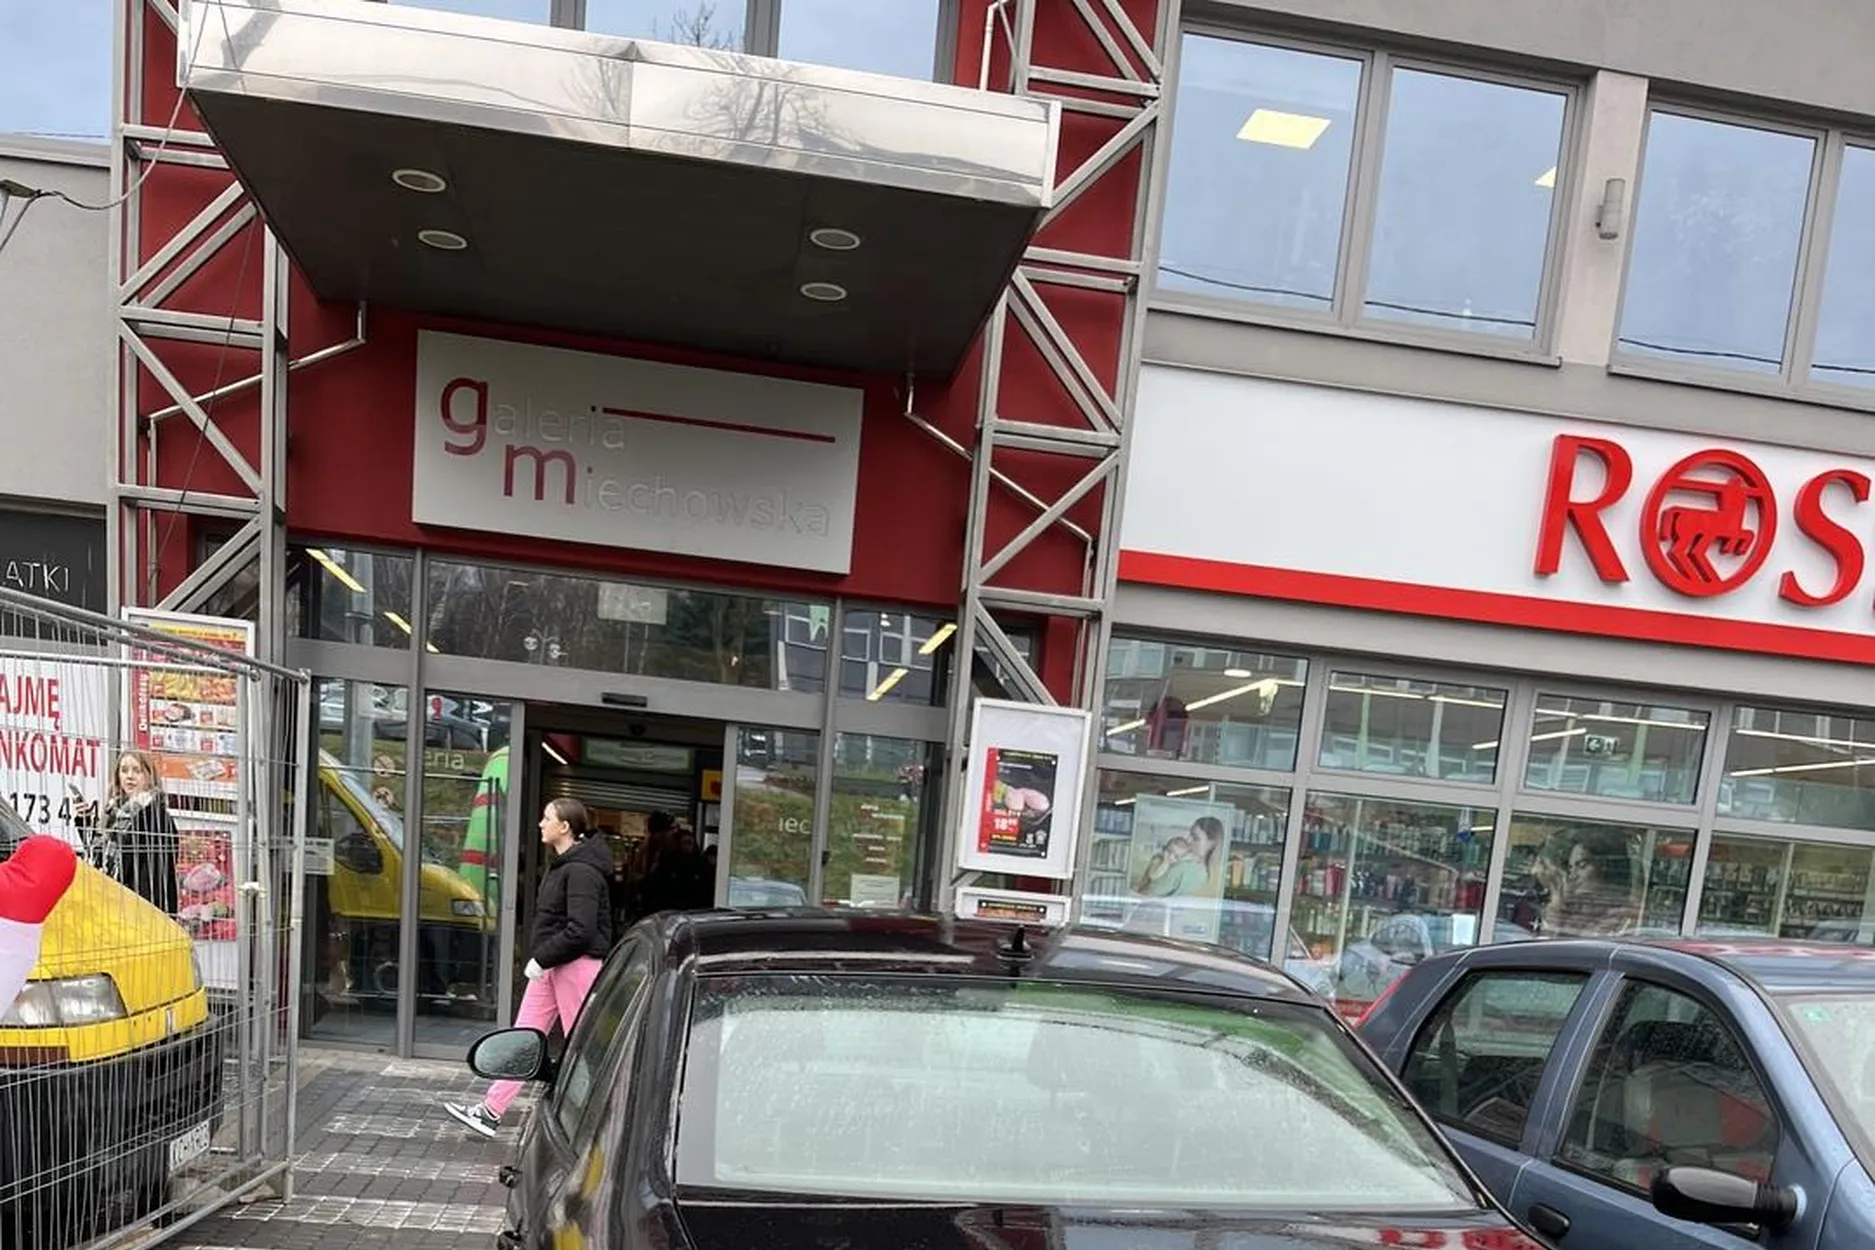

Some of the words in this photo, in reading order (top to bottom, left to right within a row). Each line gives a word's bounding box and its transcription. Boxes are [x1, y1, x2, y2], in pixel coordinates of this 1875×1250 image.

[441, 377, 625, 455] galeria
[504, 444, 831, 537] miechowska
[1534, 433, 1872, 608] ROS
[6, 561, 69, 592] ATKI
